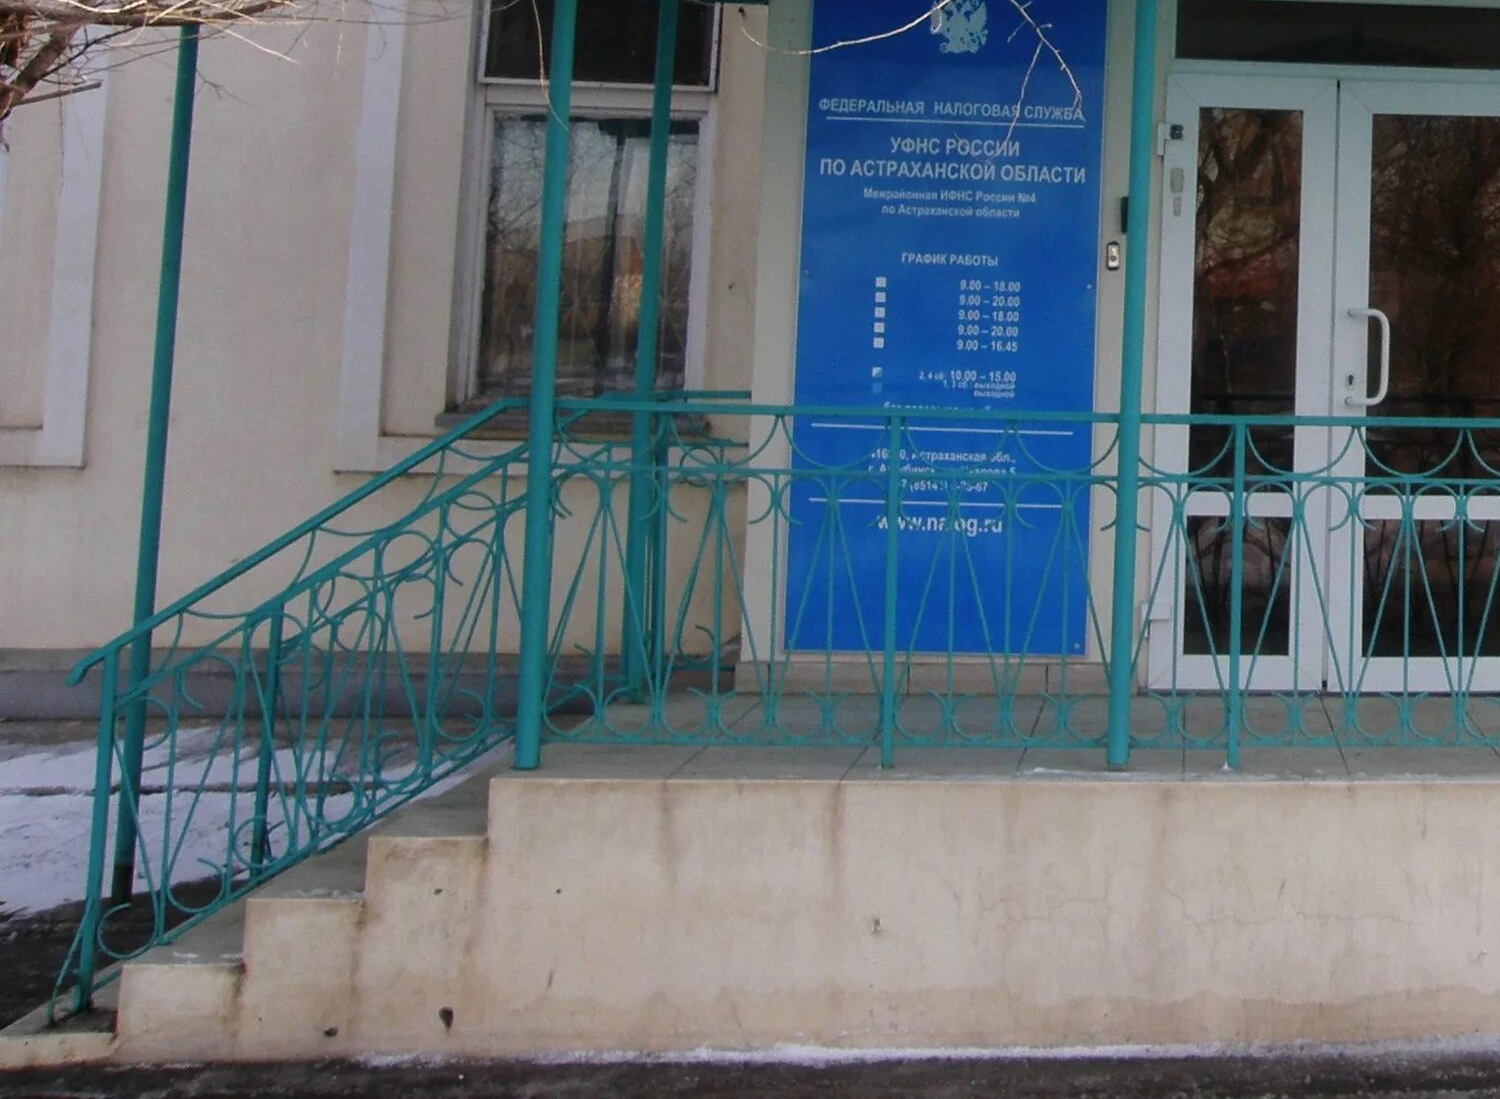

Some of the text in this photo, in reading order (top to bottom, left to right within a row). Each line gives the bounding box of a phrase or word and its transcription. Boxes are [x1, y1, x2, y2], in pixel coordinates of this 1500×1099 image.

[819, 98, 1084, 121] ФЕДЕРАЛЬНАЯ НАЛОГОВАЯ СЛУЖБА
[890, 137, 1020, 157] УФНС РОССИИ
[820, 158, 1086, 184] ПО АСТРАХАНСКОЙ ОБЛАСТИ
[863, 187, 938, 201] Межрайонная
[940, 189, 973, 201] ИФНС
[975, 191, 1015, 203] России
[881, 205, 1020, 218] по Астраханской области
[901, 252, 999, 266] ГРАФИК РАБОТЫ
